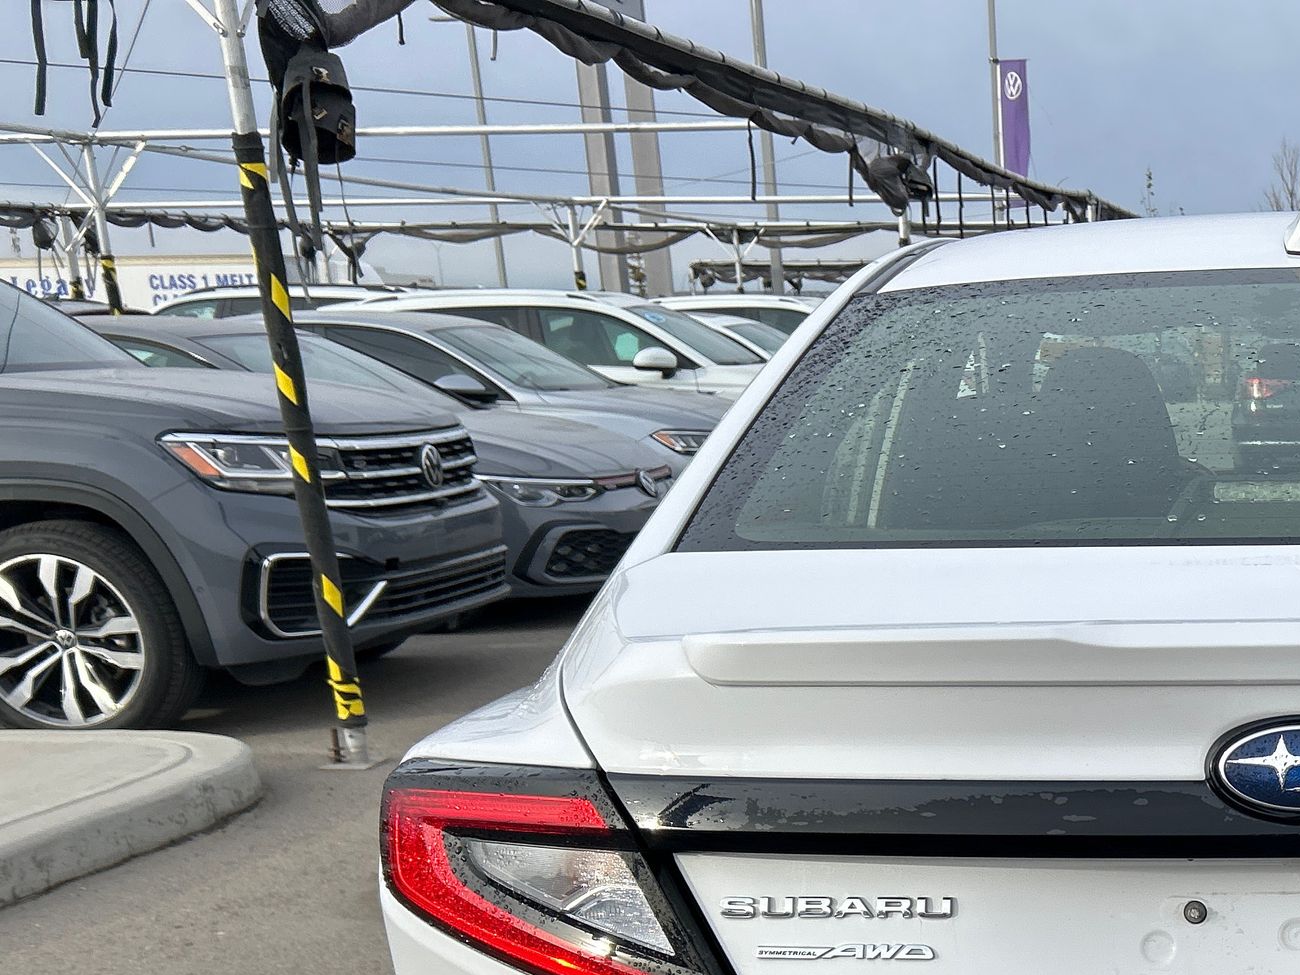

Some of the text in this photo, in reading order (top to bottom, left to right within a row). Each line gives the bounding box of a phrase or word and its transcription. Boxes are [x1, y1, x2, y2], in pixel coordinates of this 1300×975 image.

[1003, 71, 1022, 100] VW
[149, 273, 197, 290] CLASS
[202, 274, 209, 287] 1
[719, 896, 955, 918] SUBARU
[824, 943, 935, 960] AWD
